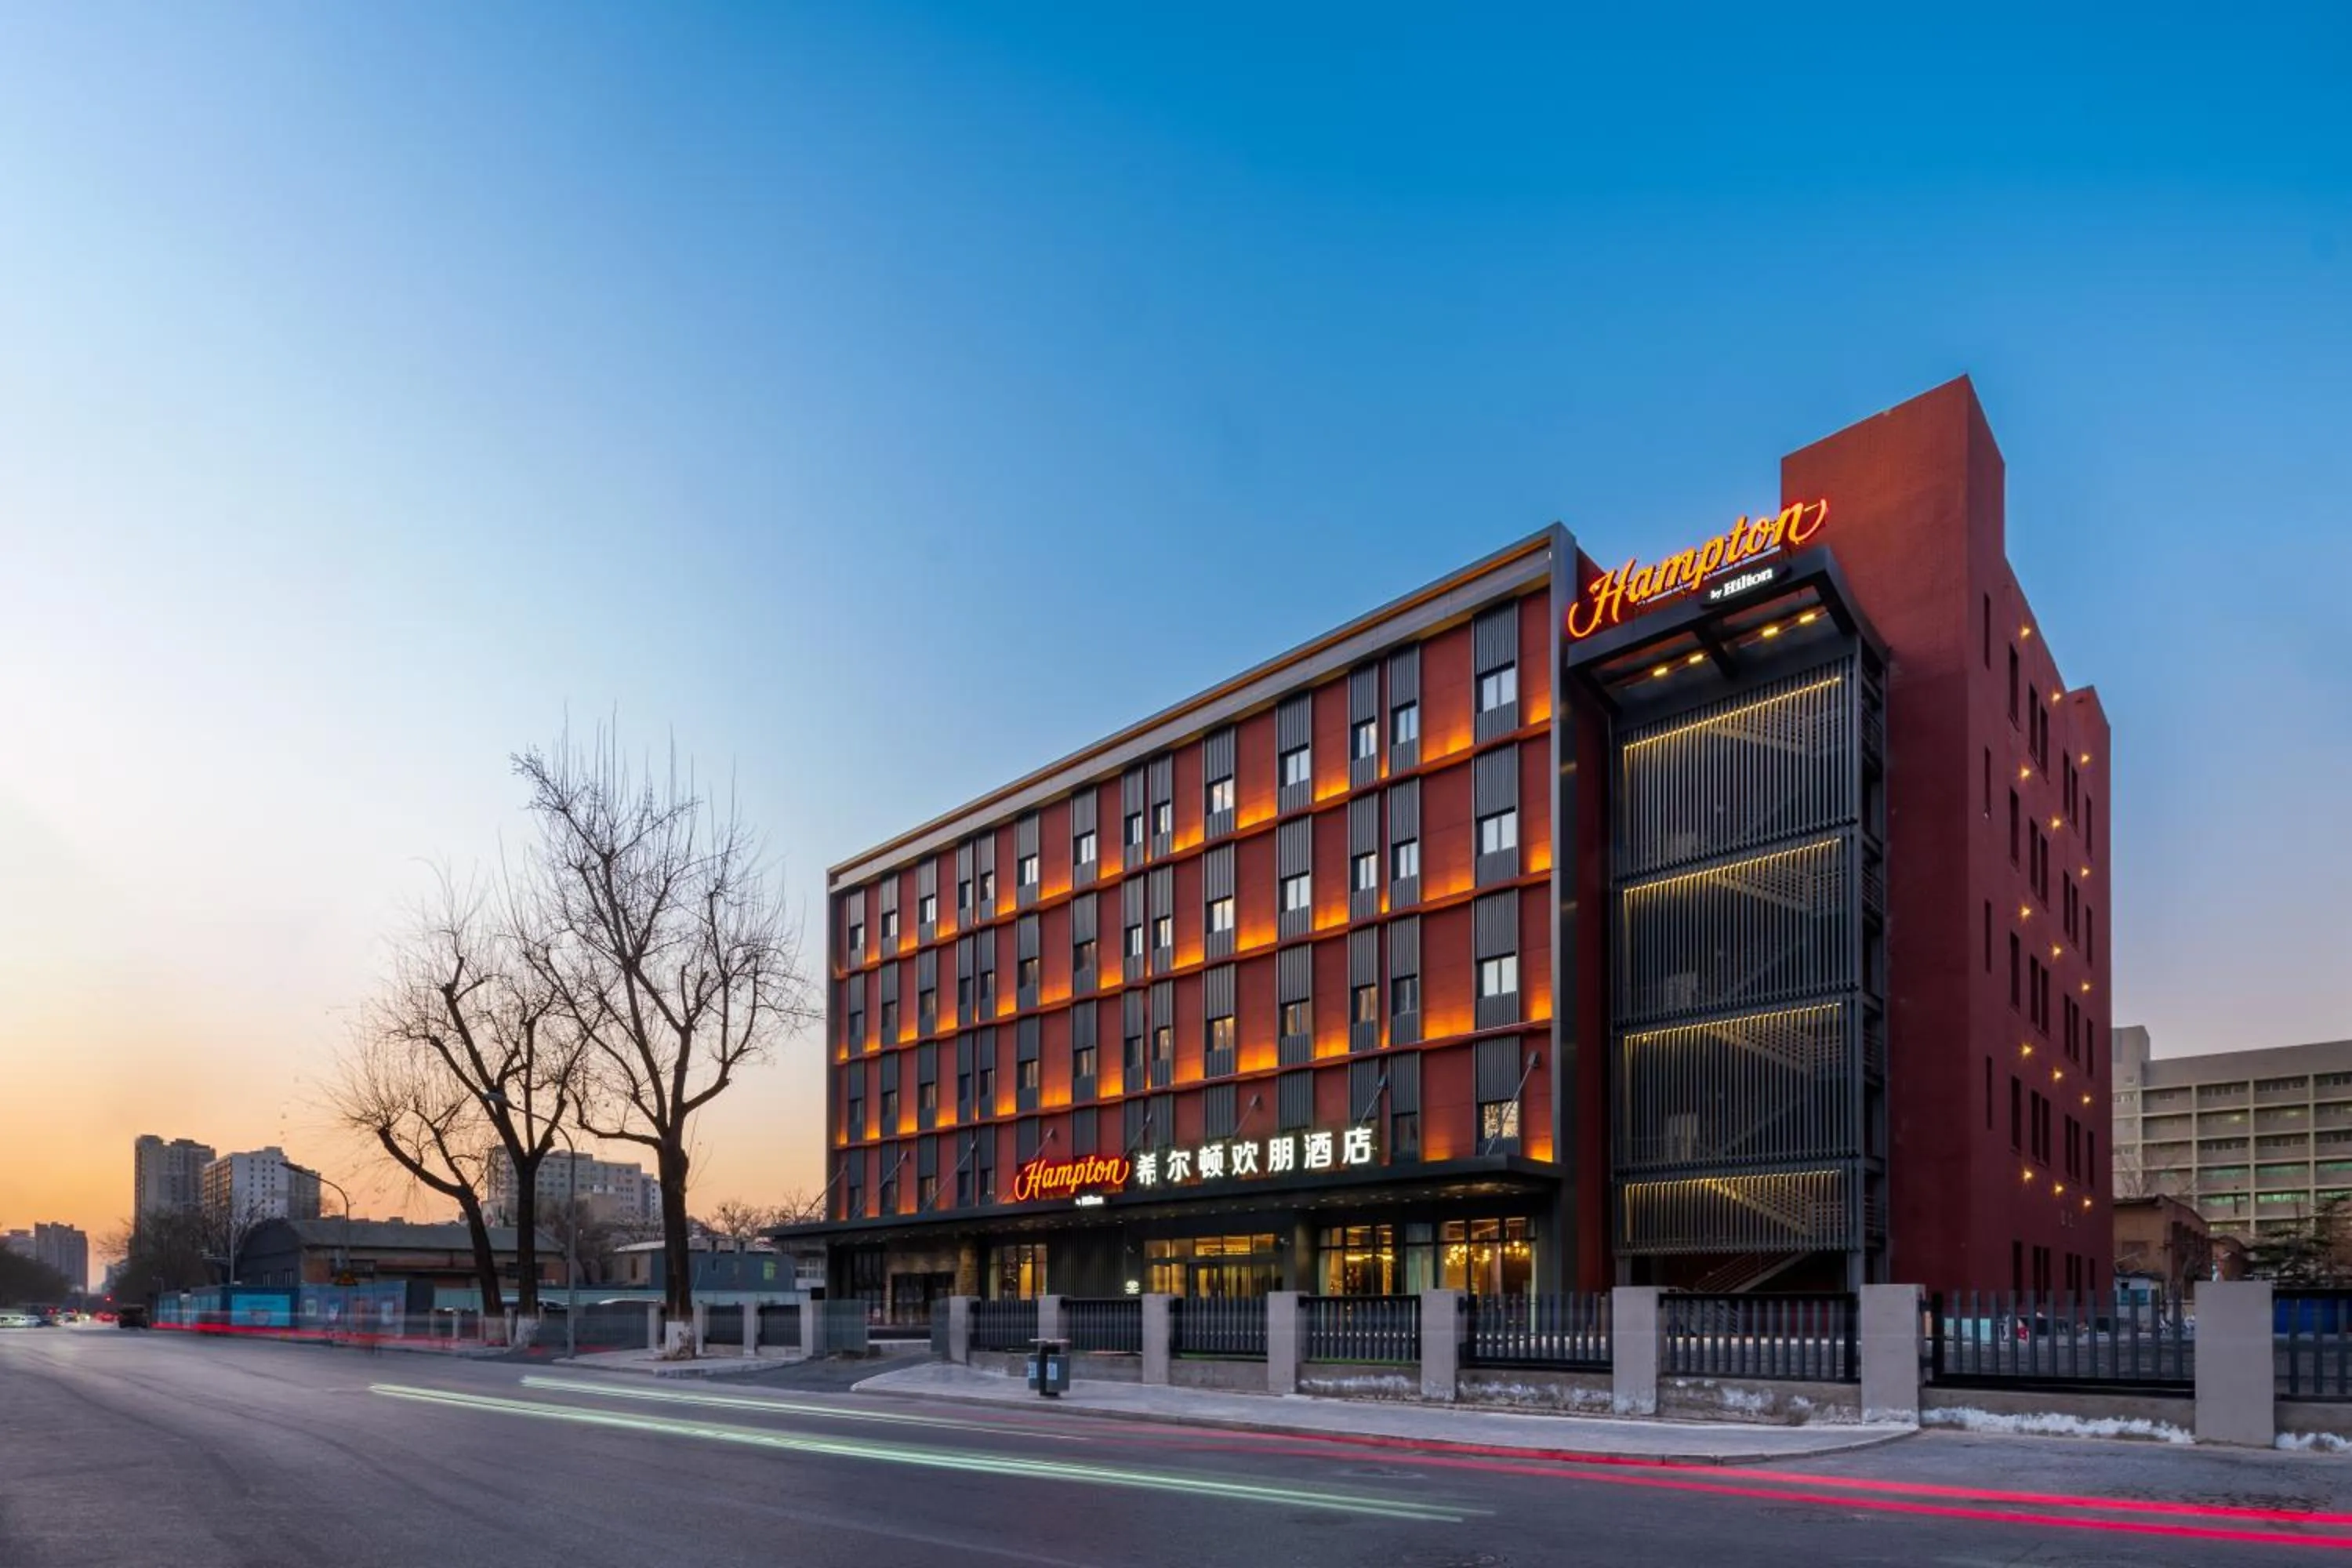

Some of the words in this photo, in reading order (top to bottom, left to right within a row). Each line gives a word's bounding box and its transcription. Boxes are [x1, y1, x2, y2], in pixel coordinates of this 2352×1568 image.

[1568, 499, 1828, 637] Hampton
[1723, 568, 1773, 597] Hilton
[1014, 1156, 1129, 1200] Hampton
[1136, 1127, 1373, 1185] 希尔顿欢朋酒店
